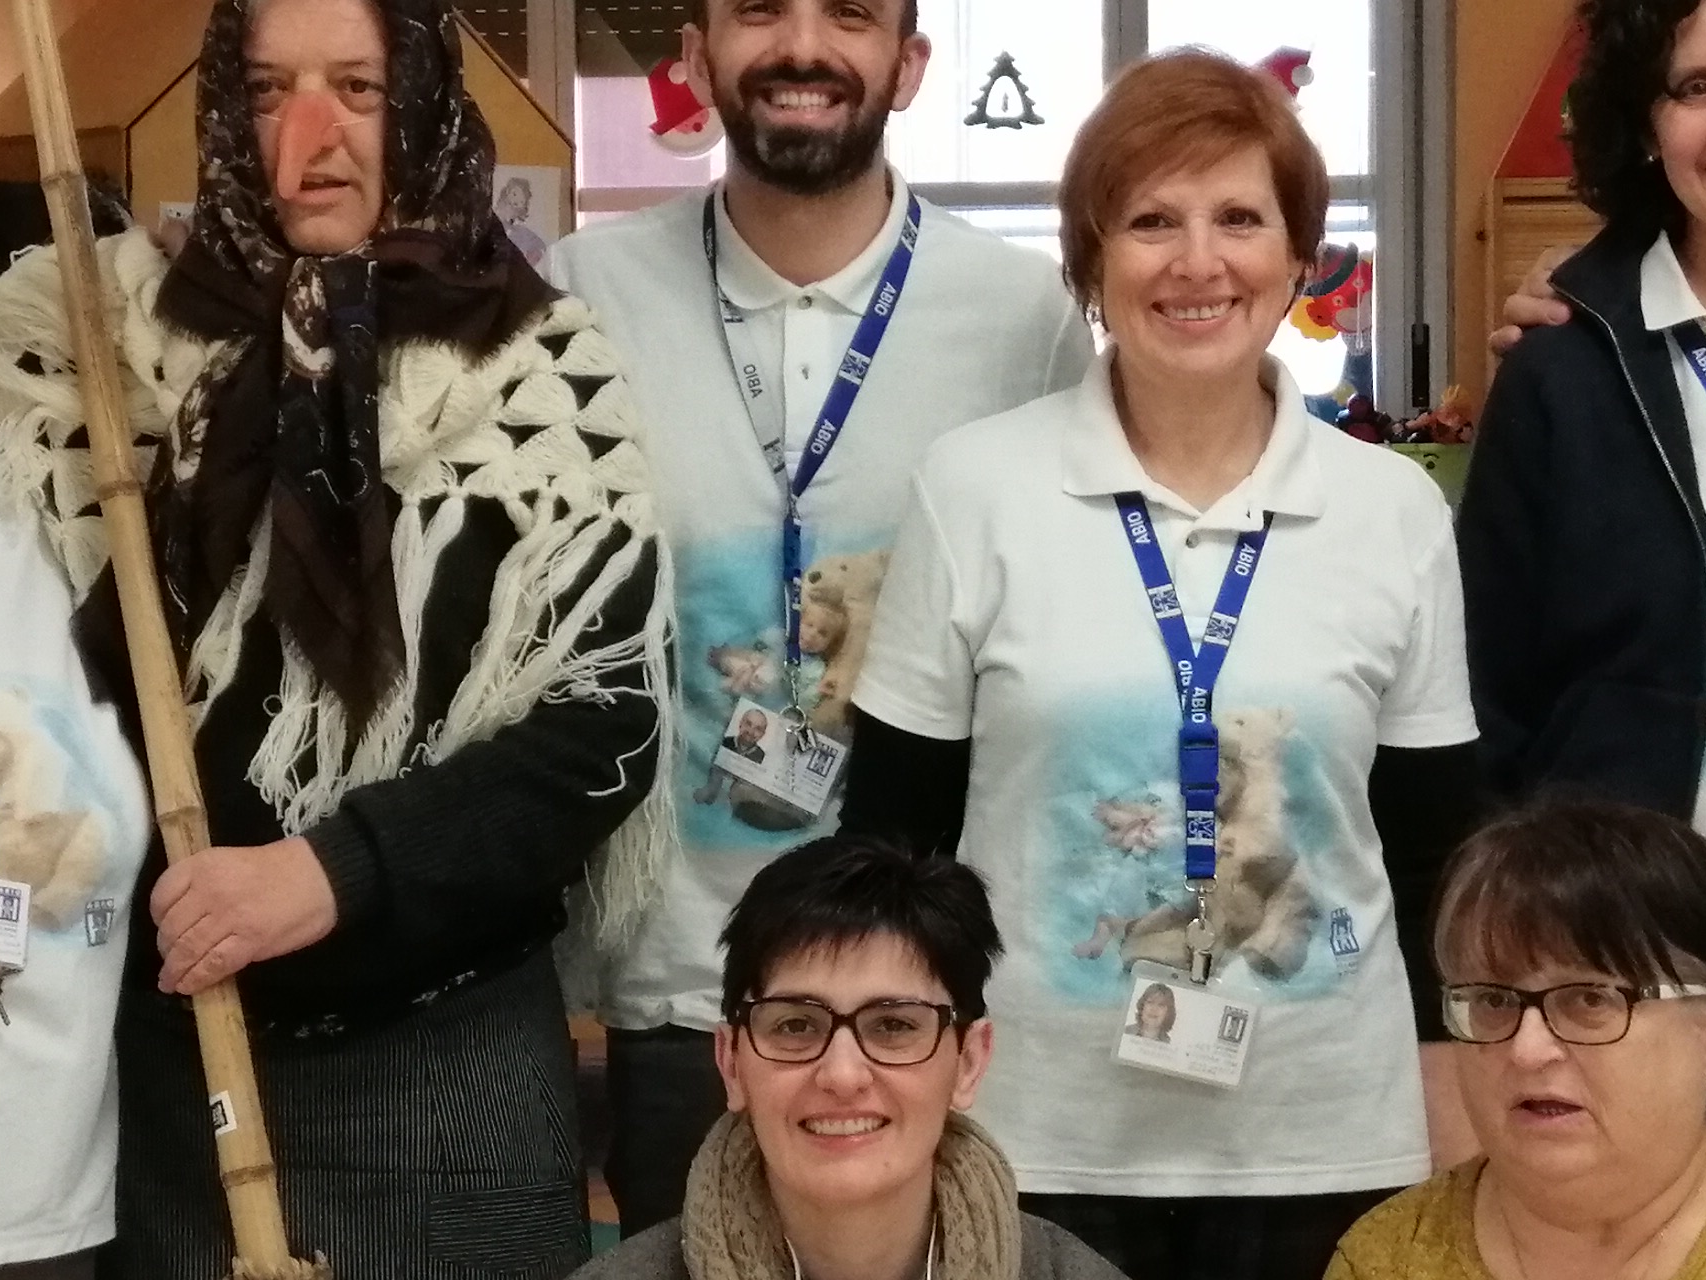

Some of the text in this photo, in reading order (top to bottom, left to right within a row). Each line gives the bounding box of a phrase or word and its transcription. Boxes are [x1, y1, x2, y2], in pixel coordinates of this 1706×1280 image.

[874, 281, 897, 317] ABIO
[811, 419, 836, 456] ABIO
[1127, 511, 1151, 544] ABIO
[1234, 543, 1257, 576] ABIO
[1191, 686, 1207, 724] ABIO
